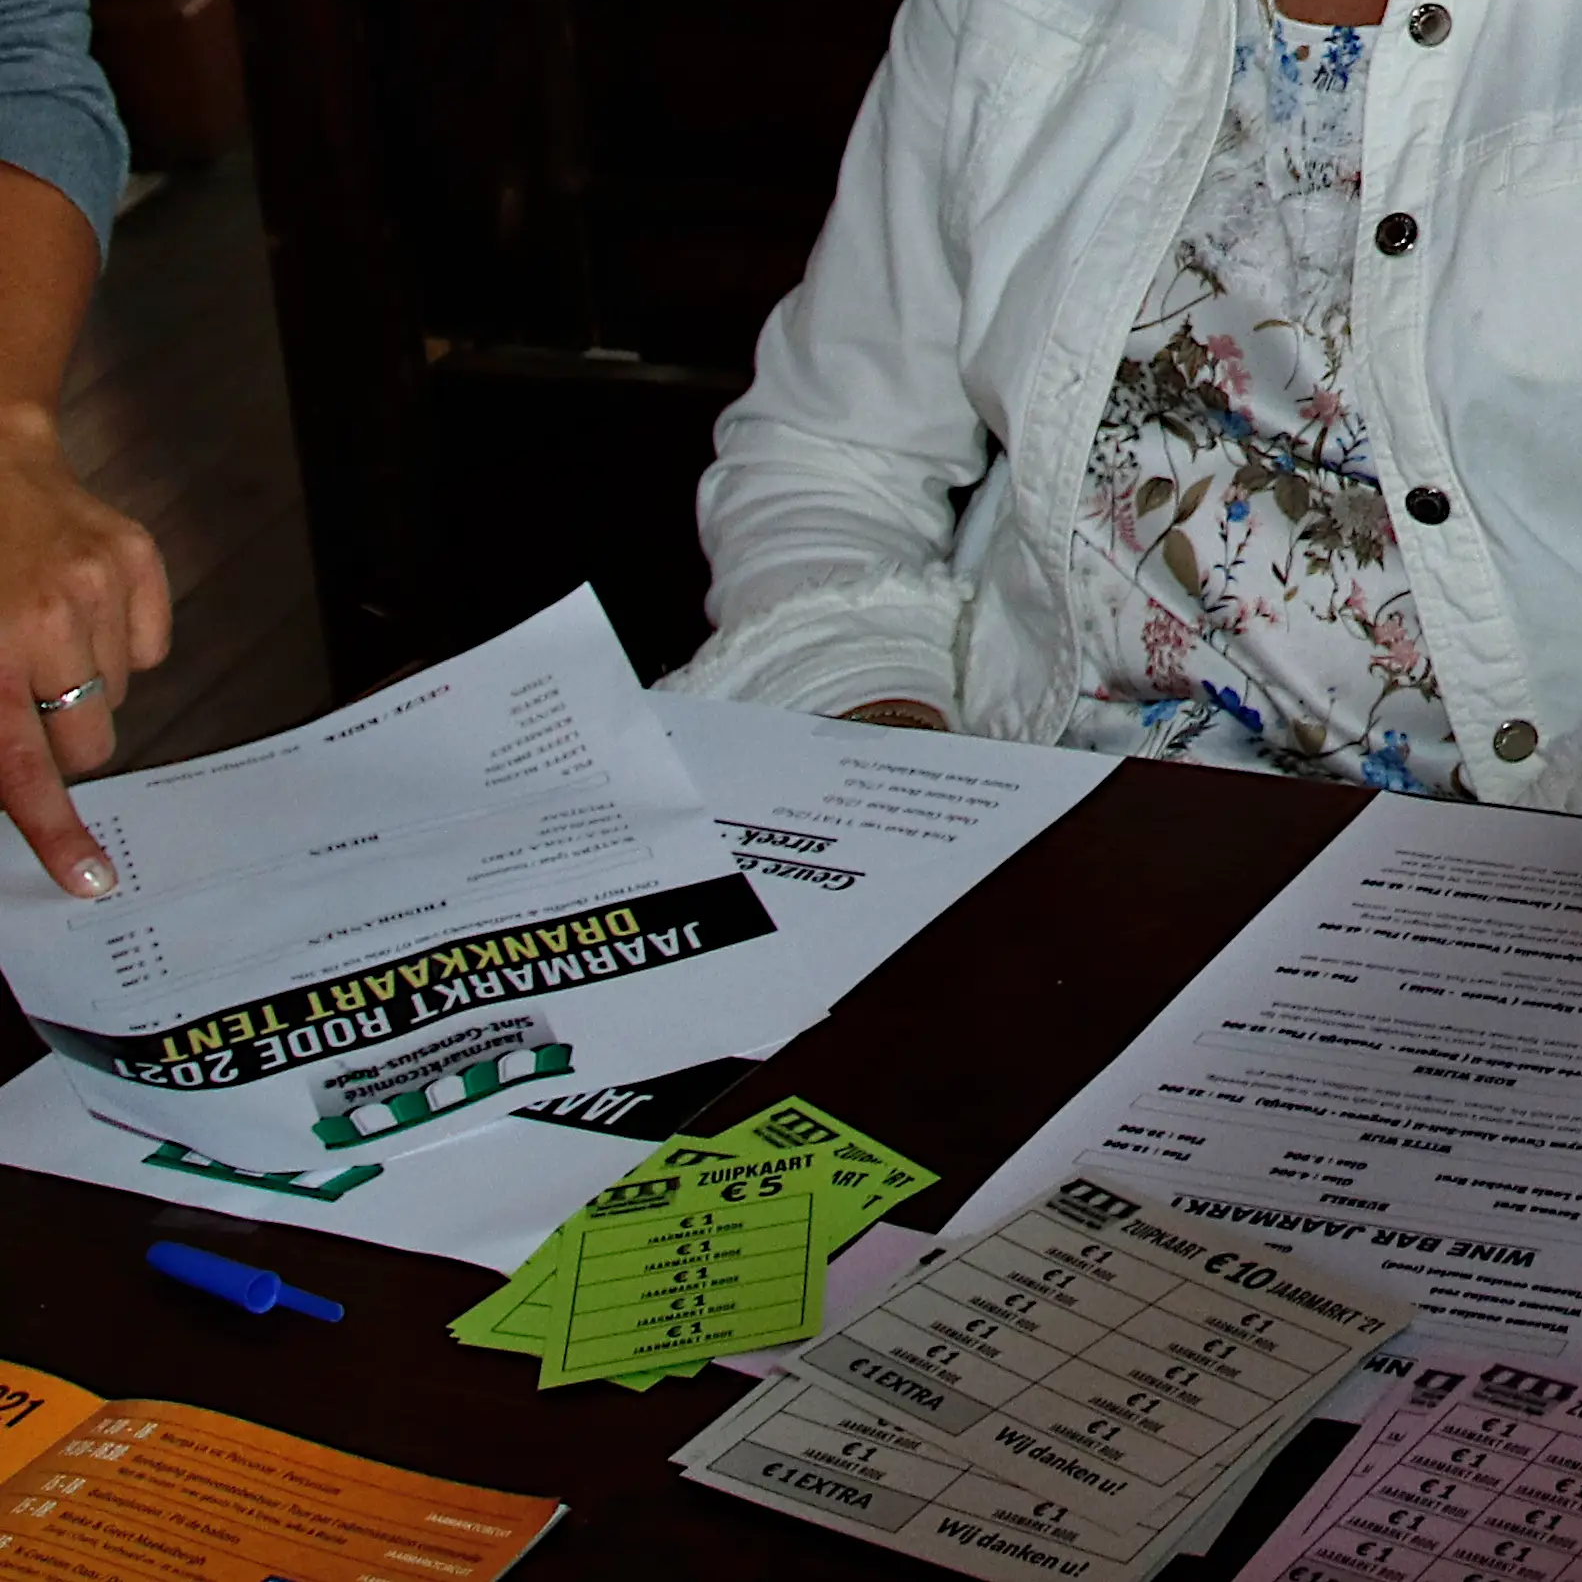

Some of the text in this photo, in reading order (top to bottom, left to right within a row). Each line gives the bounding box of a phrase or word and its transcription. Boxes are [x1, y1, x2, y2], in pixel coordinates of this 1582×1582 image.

[763, 860, 855, 893] Geuze
[304, 907, 642, 1023] DRANKKAART
[112, 921, 702, 1088] JAARMARKT RODE 2021
[160, 1005, 290, 1065] TENT
[322, 1015, 535, 1092] Sint-Genesius-Rode
[344, 1031, 526, 1104] Jaarmarktcomité
[697, 1154, 815, 1187] ZUIPKAART
[1371, 1229, 1443, 1255] BAR
[1446, 1240, 1538, 1269] WINE
[1121, 1219, 1209, 1261] ZUIPKAART
[1266, 1280, 1363, 1326] JAARMARKT
[871, 1369, 946, 1412] EXTRA
[794, 1473, 874, 1511] EXTRA
[1030, 1446, 1104, 1493] danken
[975, 1531, 1063, 1572] danken
